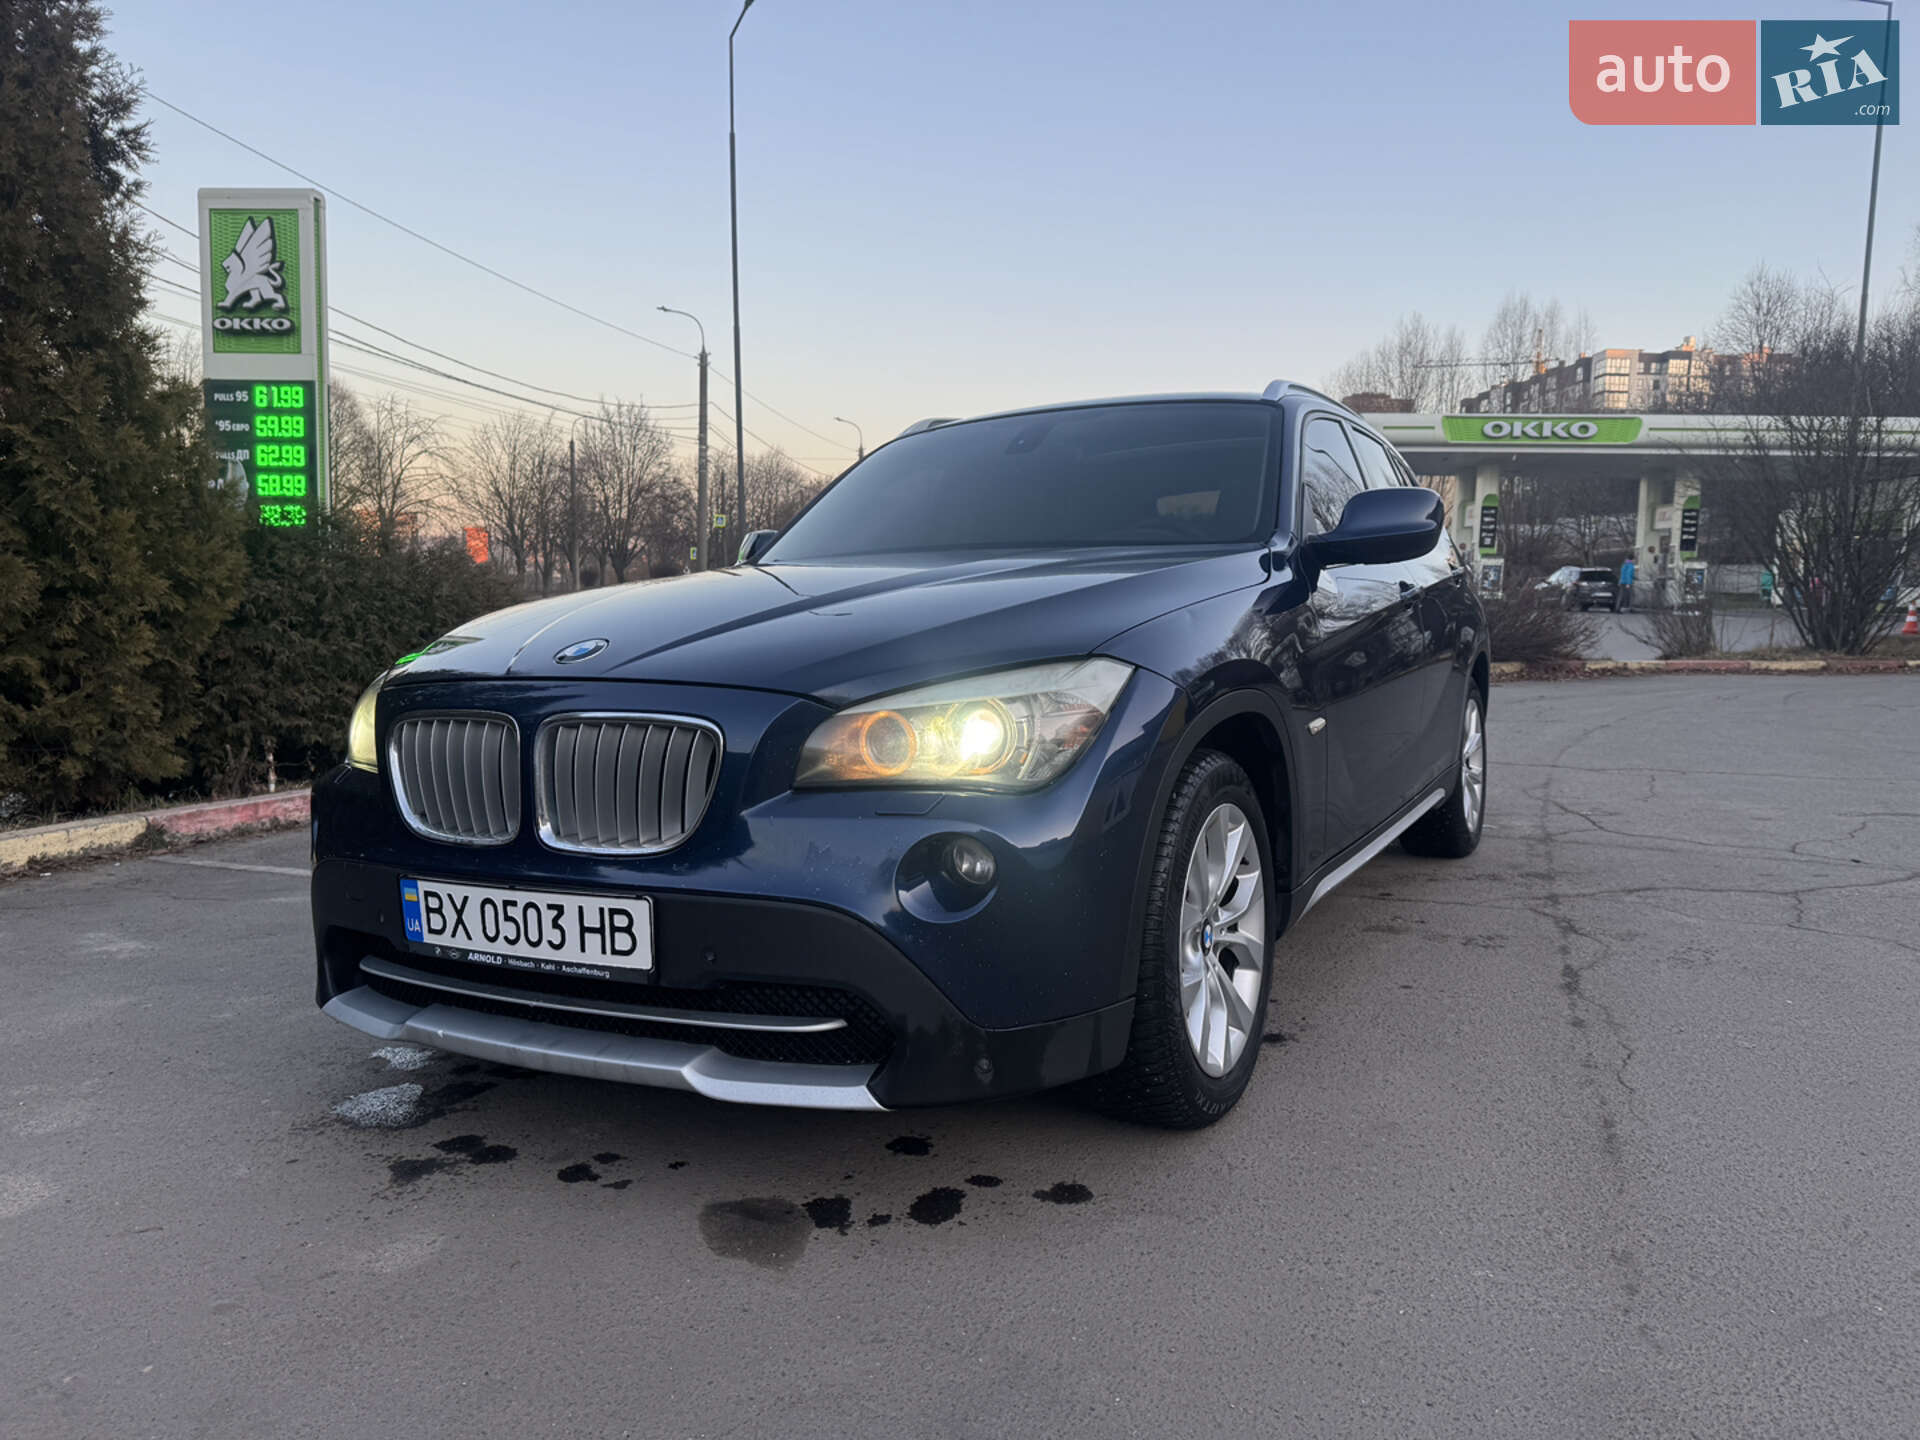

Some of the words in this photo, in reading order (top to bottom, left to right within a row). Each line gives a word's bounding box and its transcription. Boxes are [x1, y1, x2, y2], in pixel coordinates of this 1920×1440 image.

[213, 317, 292, 332] OKKO
[214, 393, 234, 401] PULLS
[235, 390, 249, 402] 95
[254, 385, 305, 408] 61.99
[255, 415, 305, 438] 59.99
[1482, 420, 1598, 440] OKKO
[256, 444, 306, 467] 62.99
[257, 474, 307, 496] 58.99
[407, 918, 422, 933] UA
[423, 890, 473, 941] BX
[480, 897, 567, 951] 0503
[578, 905, 638, 957] HB
[467, 952, 502, 965] ARNOLD
[541, 962, 557, 971] Kahl
[562, 964, 610, 979] Aschaffenburg
